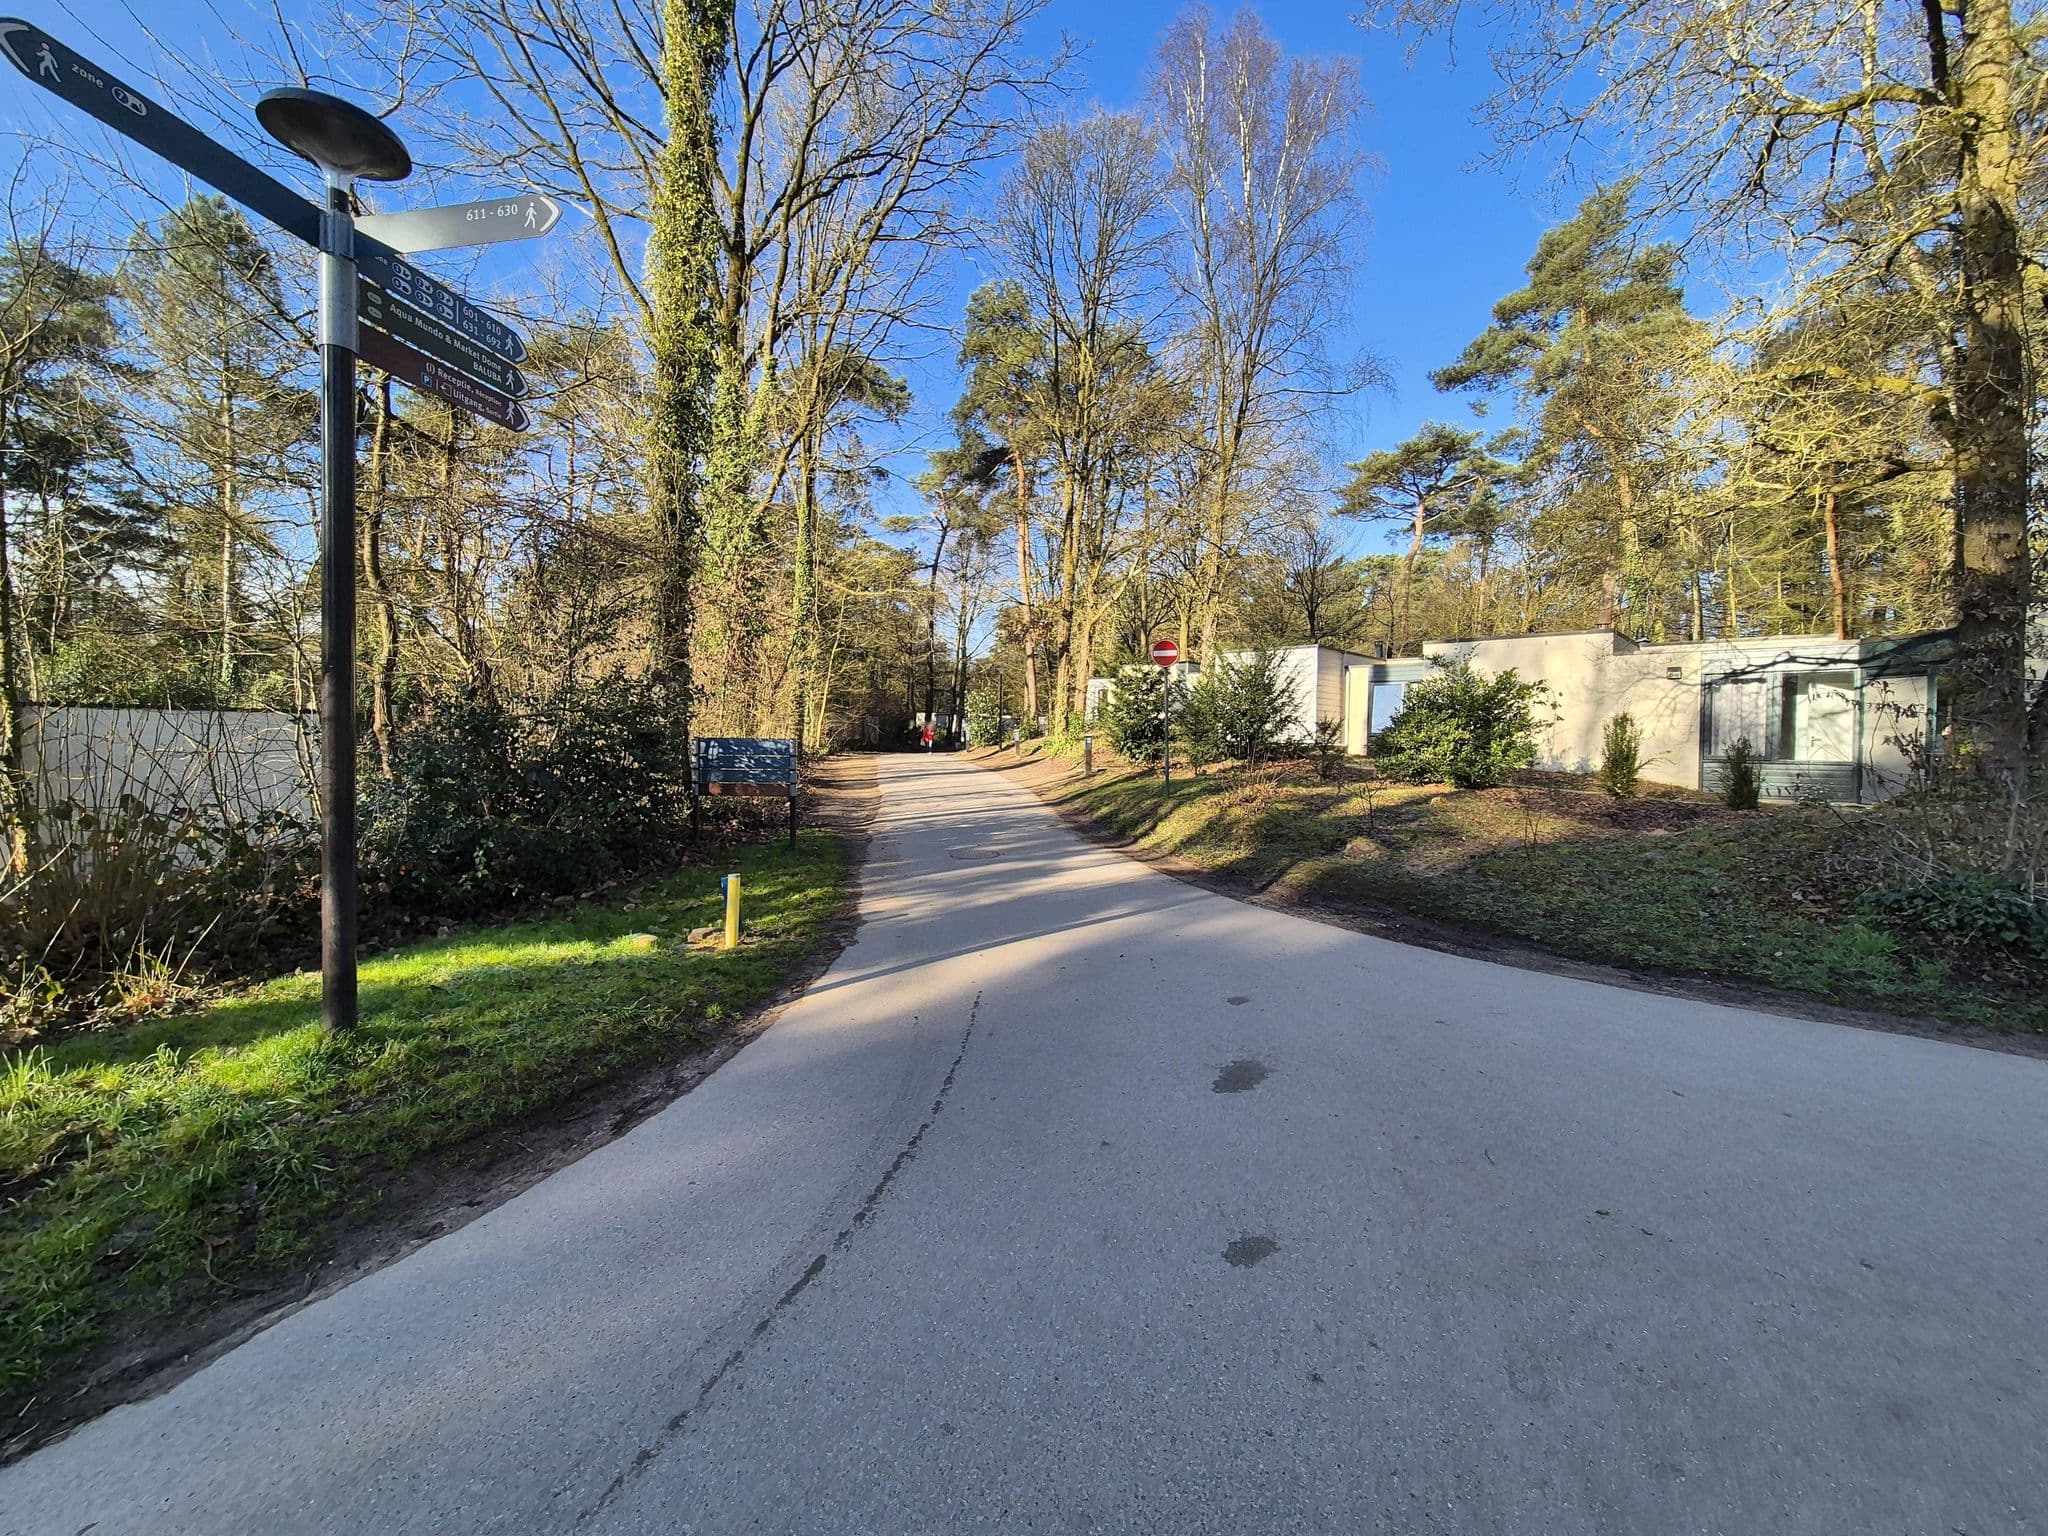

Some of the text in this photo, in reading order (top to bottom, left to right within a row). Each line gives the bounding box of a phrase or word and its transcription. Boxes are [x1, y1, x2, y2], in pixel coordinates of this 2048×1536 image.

[71, 63, 104, 88] zone
[466, 206, 487, 221] 611
[498, 204, 518, 218] 630
[463, 306, 478, 322] 601
[486, 321, 501, 335] 610
[390, 303, 413, 323] Aqua
[415, 316, 444, 340] Mundo
[444, 334, 452, 344] &
[453, 337, 480, 361] Market
[481, 354, 502, 371] Dome
[463, 320, 478, 336] 631
[486, 334, 501, 349] 692
[437, 368, 474, 394] Receptie,
[473, 361, 502, 384] BALUBA
[453, 389, 485, 412] Uitgang,
